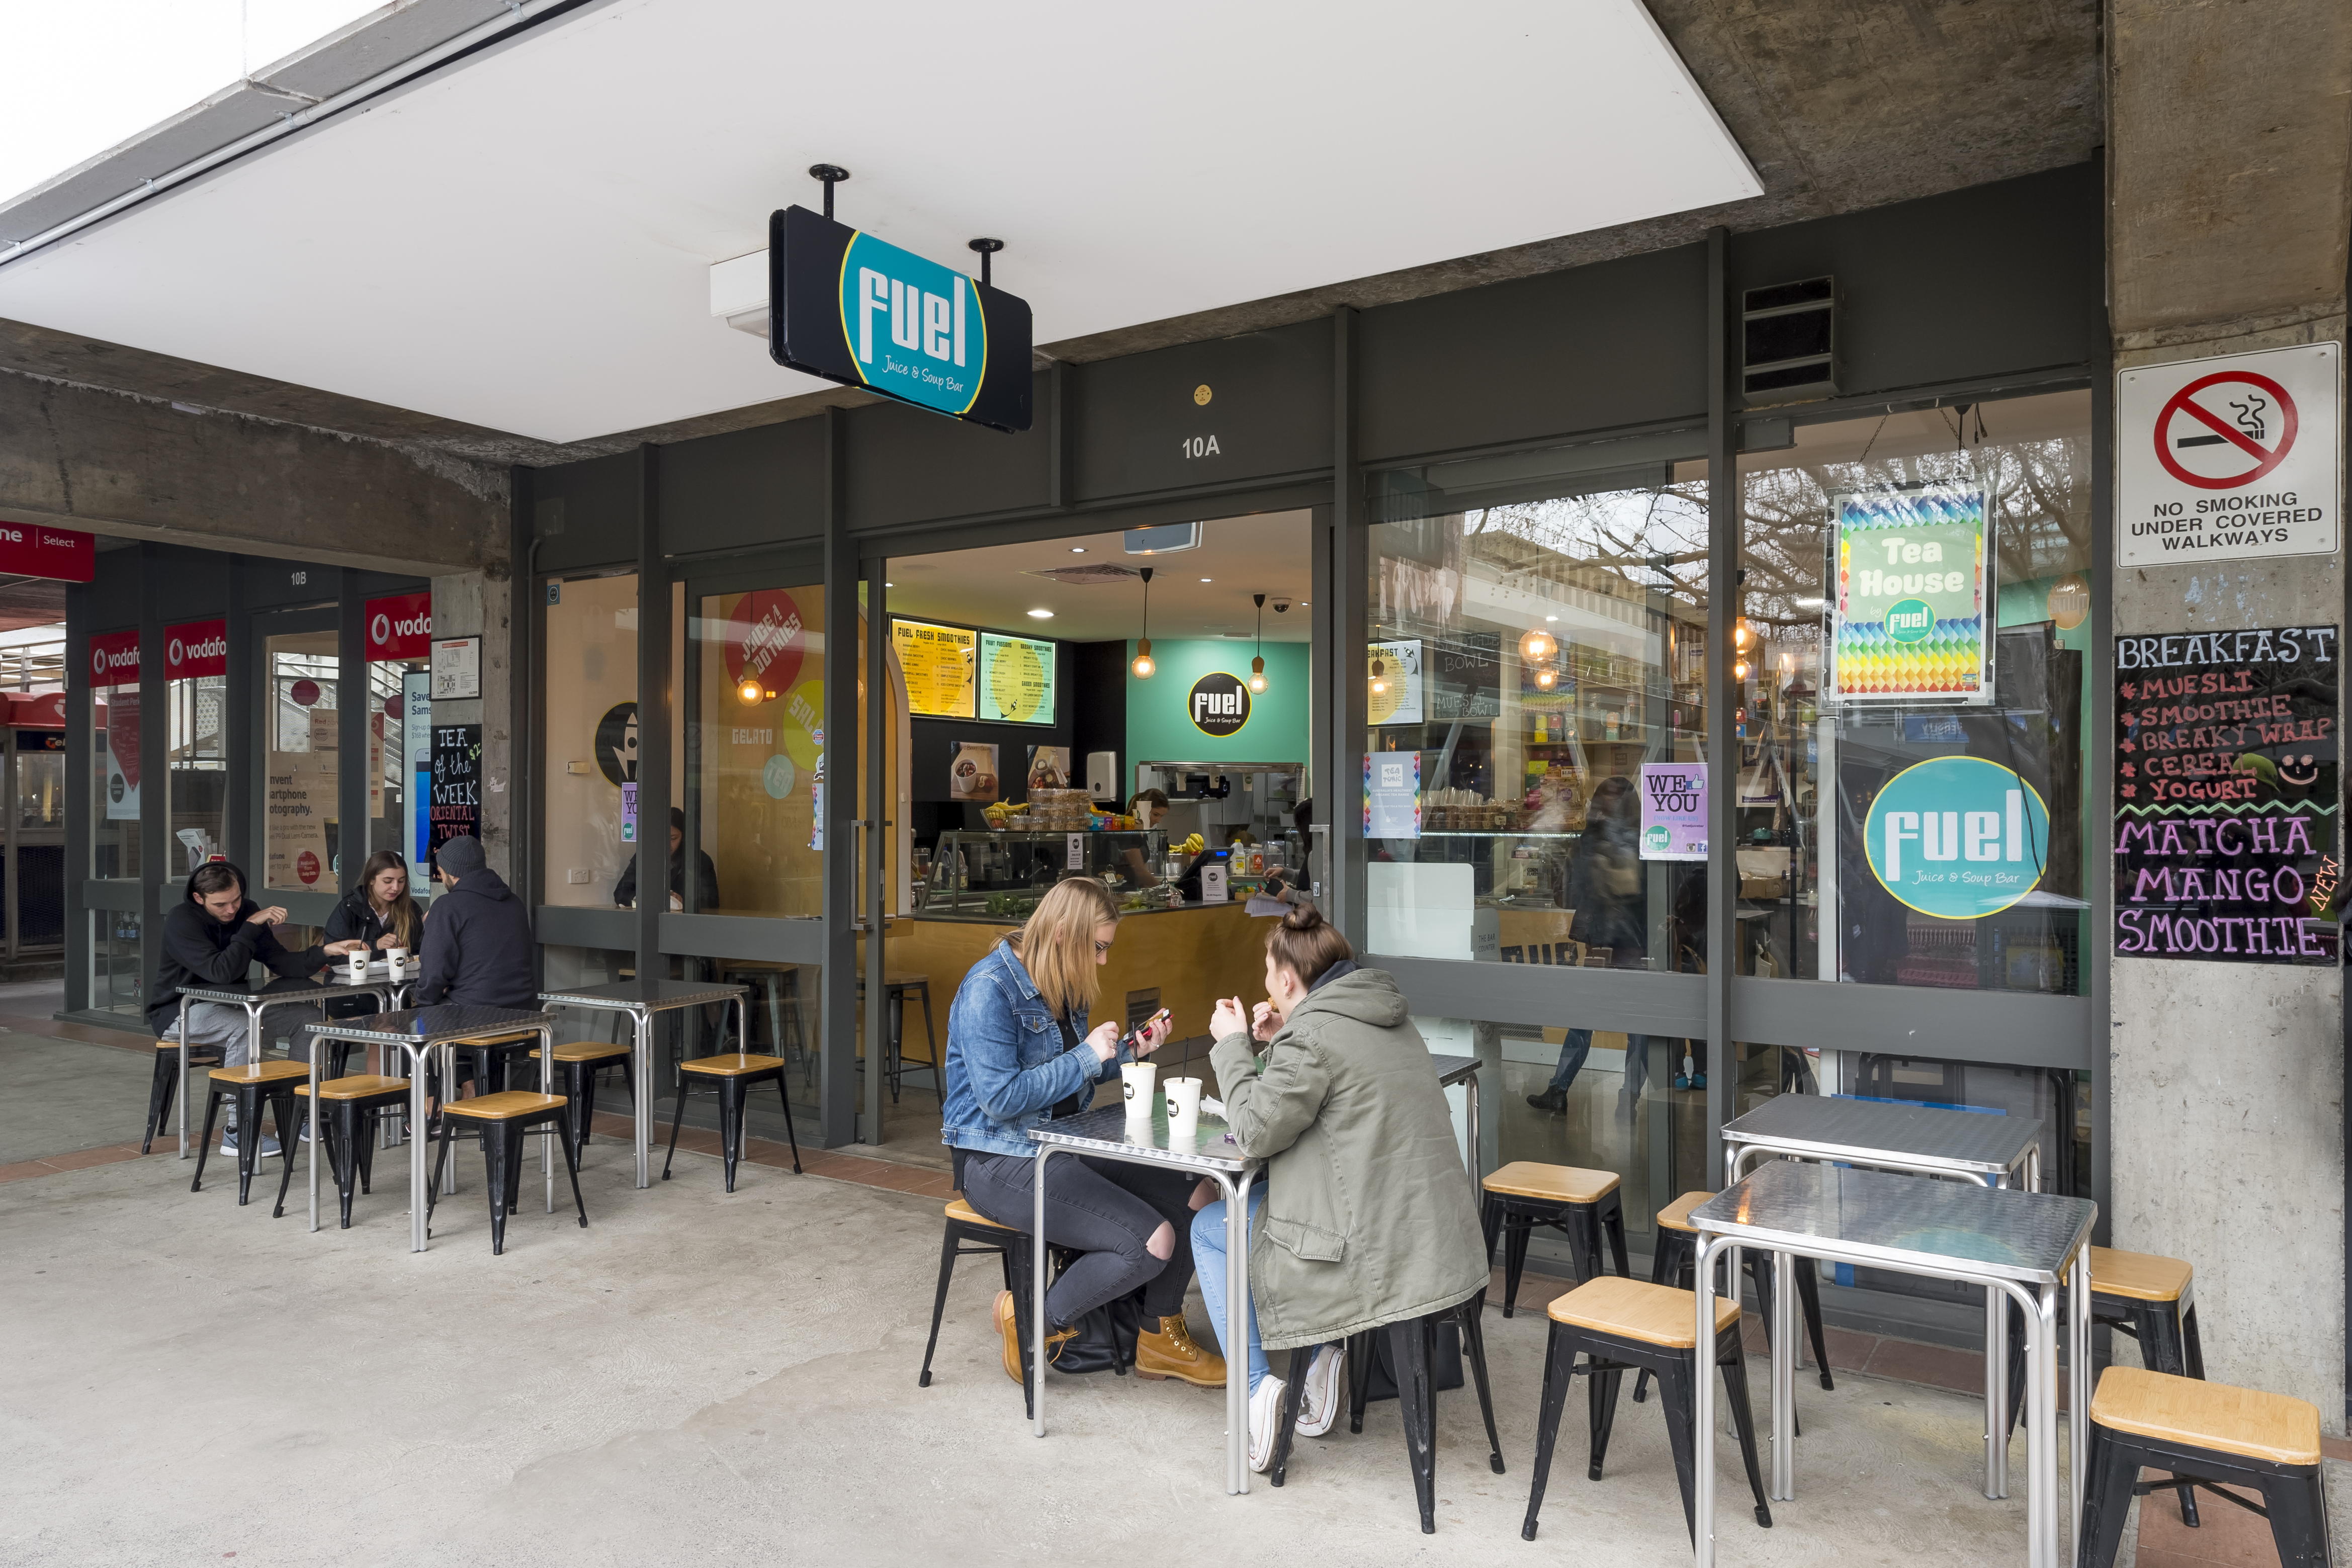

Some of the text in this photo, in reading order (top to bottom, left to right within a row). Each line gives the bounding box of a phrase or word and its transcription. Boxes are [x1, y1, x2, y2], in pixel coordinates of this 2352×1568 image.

[859, 267, 965, 368] fuel
[882, 355, 964, 392] Juice & Soup Bar
[1182, 435, 1220, 459] 10A
[2154, 492, 2297, 517] NO SMOKING
[2131, 507, 2322, 536] UNDER COVERED
[43, 535, 74, 548] Select
[1881, 537, 1943, 565] Tea
[2162, 528, 2289, 551] WALKWAYS
[291, 571, 306, 585] 10B
[1859, 569, 1964, 597] House
[1870, 606, 1882, 618] by
[1889, 606, 1928, 634] fuel
[394, 613, 431, 637] voda
[898, 627, 970, 645] FUEL FRESH SMOOTHIES
[186, 636, 226, 659] vodafo
[2118, 628, 2335, 669] BREAKFAST
[1445, 653, 1489, 672] BOWL
[412, 691, 429, 702] Save
[2141, 670, 2253, 700] MUESLI
[111, 698, 129, 707] Student
[1195, 685, 1242, 722] fuel
[1436, 692, 1485, 710] MUESLI
[1462, 705, 1498, 717] BOWL
[2141, 694, 2292, 726] SMOOTHIE
[439, 728, 468, 747] TEA
[732, 729, 772, 745] GELATO
[2143, 718, 2331, 751] BREAKY WRAP
[435, 752, 471, 783] of the
[1384, 767, 1400, 775] TEA
[2144, 752, 2257, 777] CEREAL
[270, 775, 293, 785] nvent
[766, 760, 789, 793] TEA
[1645, 775, 1686, 793] WE
[433, 780, 478, 805] WEEK
[2150, 779, 2257, 801] YOGURT
[270, 803, 312, 816] otography.
[430, 806, 475, 821] ORIENTAL
[1650, 793, 1700, 812] YOU
[438, 824, 470, 839] TWIST
[1647, 830, 1668, 846] fuel
[1885, 789, 2022, 882] fuel
[2115, 817, 2317, 855] MATCHA
[1912, 870, 2020, 887] Juice & Soup Bar
[2130, 865, 2304, 904] MANGO
[2310, 855, 2338, 911] NEW
[1478, 934, 1487, 943] THE
[2118, 909, 2325, 956] SMOOTHIE
[1478, 943, 1495, 952] COUNTER
